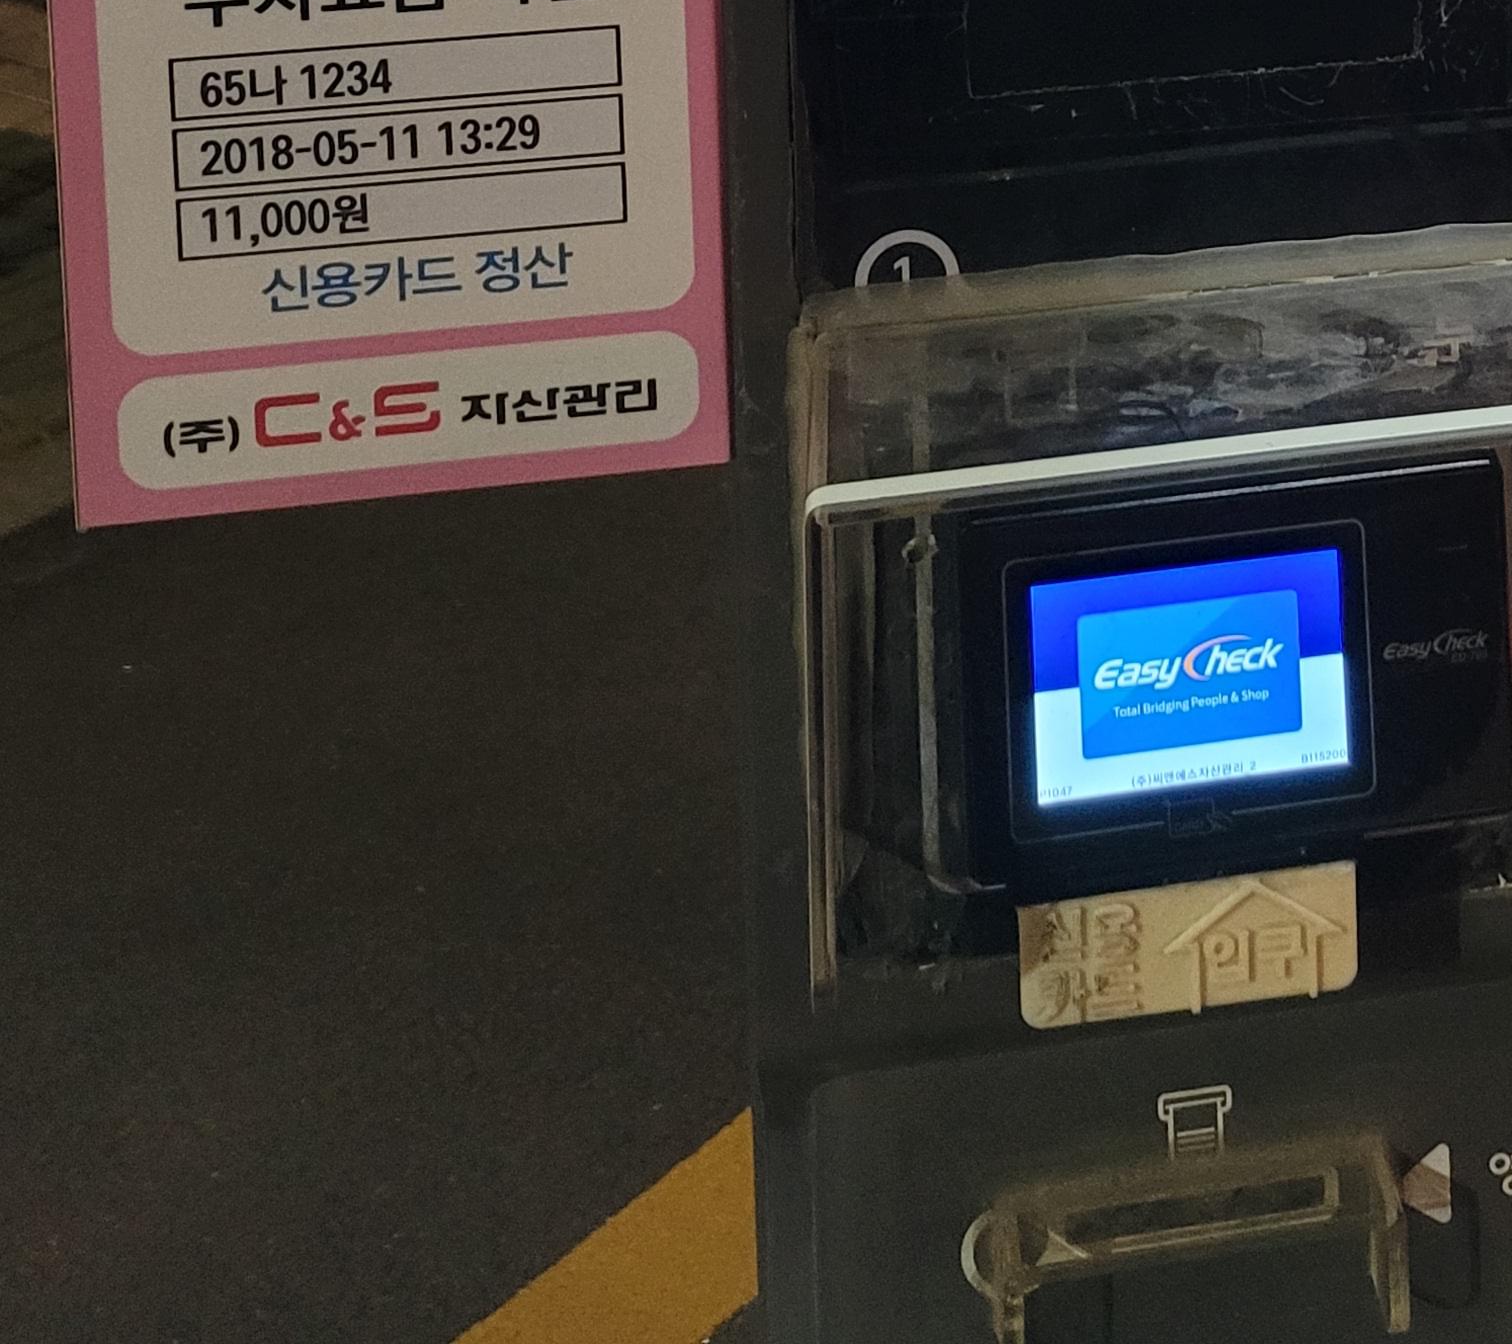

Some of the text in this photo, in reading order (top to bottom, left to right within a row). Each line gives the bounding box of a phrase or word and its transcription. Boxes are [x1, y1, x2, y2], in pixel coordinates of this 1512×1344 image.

[200, 58, 392, 108] 65나 1234
[201, 114, 541, 176] 2018-05-11 13:29
[201, 193, 370, 247] 11,000원
[262, 243, 572, 312] 신용카드 정산
[163, 414, 240, 458] (주)
[460, 378, 658, 424] 자산관리
[1093, 635, 1284, 690] EasyCheck
[1113, 688, 1269, 719] Total Bridging People Shop
